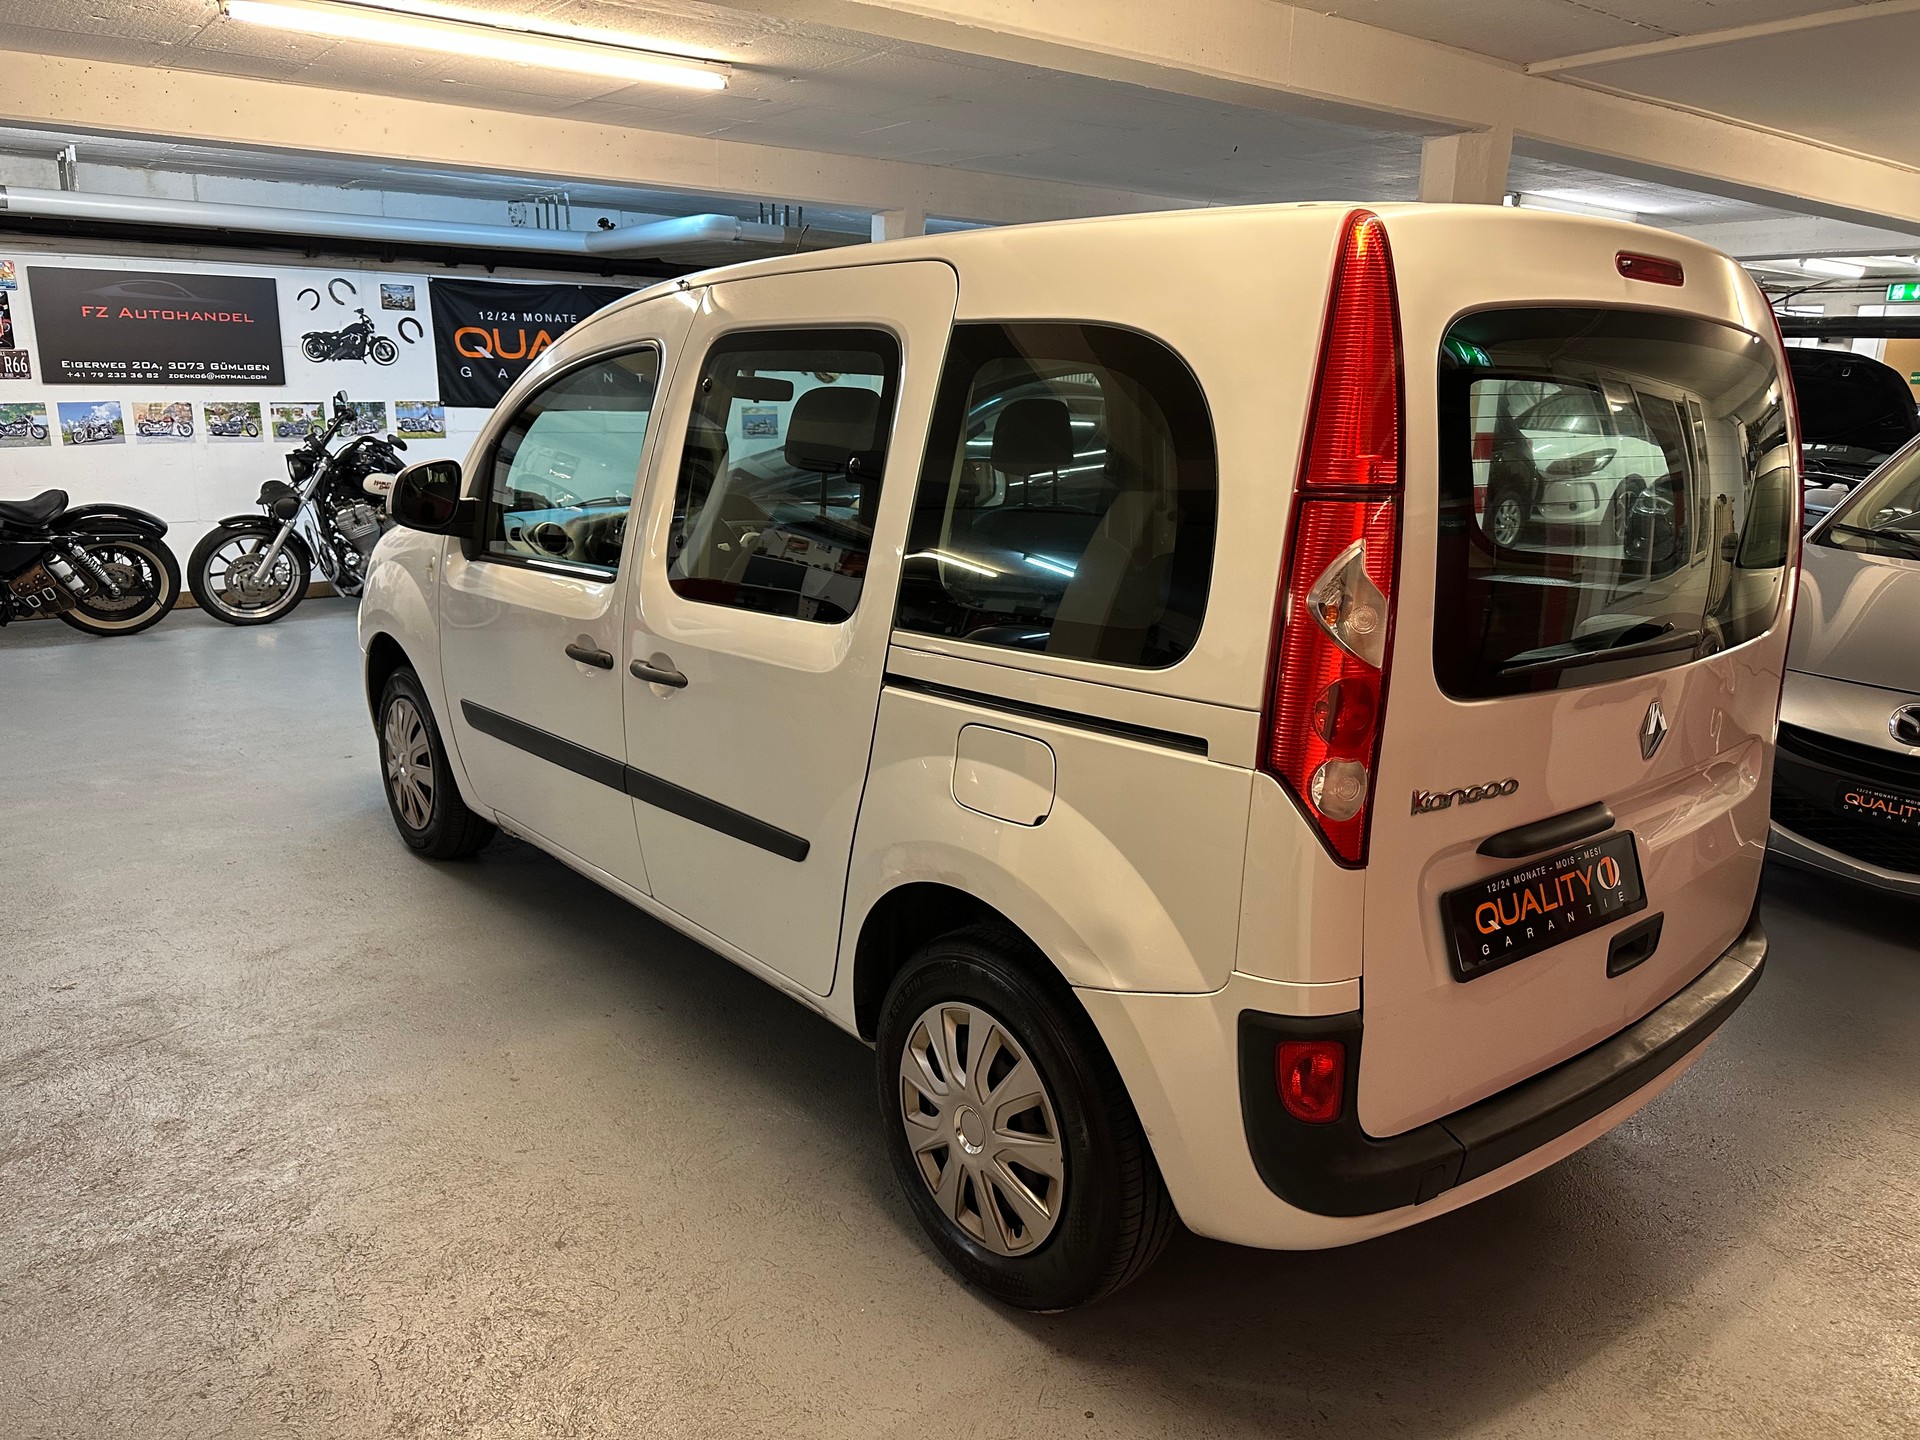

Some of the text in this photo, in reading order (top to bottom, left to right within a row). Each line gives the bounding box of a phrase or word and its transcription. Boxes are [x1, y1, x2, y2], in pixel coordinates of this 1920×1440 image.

[81, 305, 255, 323] FZ AUTOHANDEL
[478, 311, 578, 324] 12/24 MONATE
[454, 326, 554, 360] QUA
[4, 356, 28, 373] R66
[61, 360, 270, 372] EIGERWEG 20A, 3073 GÜMLIGEN
[1845, 793, 1920, 817] QUALIT
[1874, 792, 1898, 800] MONATE
[1843, 804, 1920, 827] GARANT
[1487, 880, 1511, 893] 12/24
[1513, 865, 1546, 884] MONATE
[1556, 855, 1575, 870] MOIS
[1583, 846, 1602, 860] MESI
[1475, 865, 1593, 934] QUALITY
[1482, 891, 1625, 955] GARANTIE
